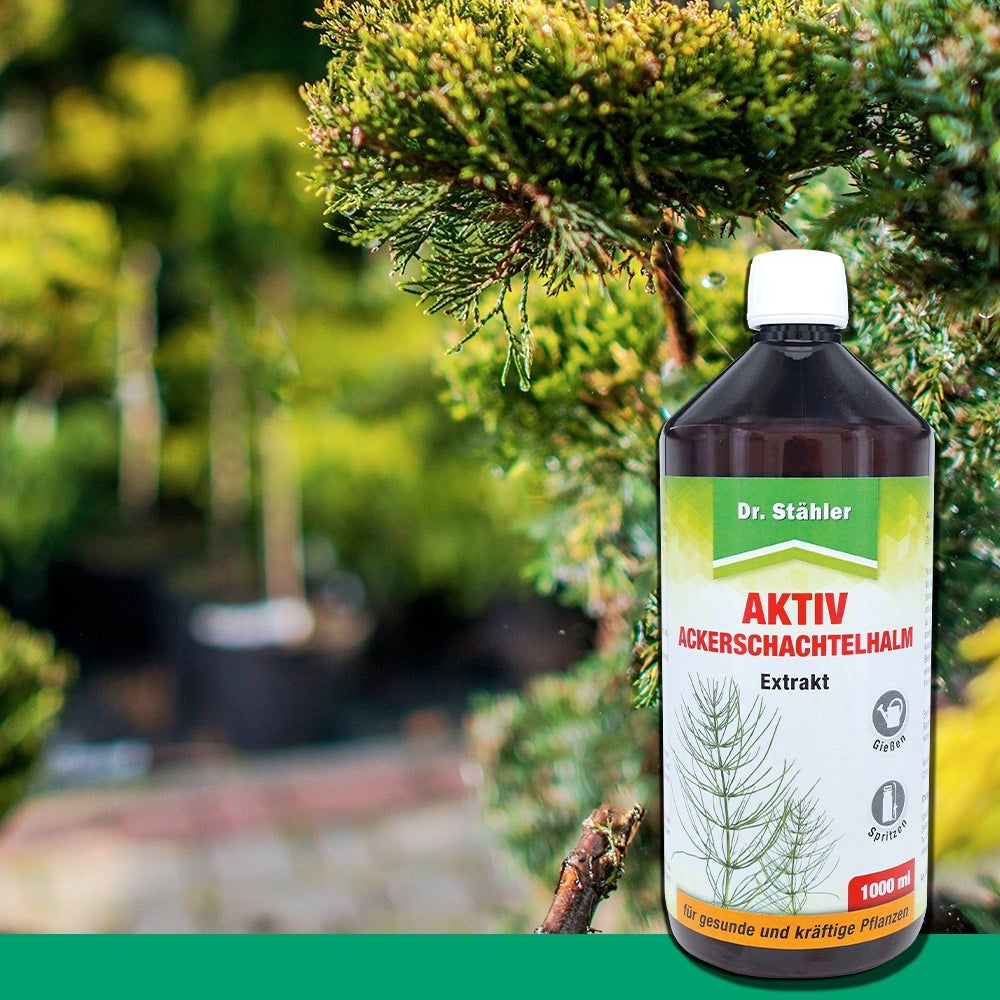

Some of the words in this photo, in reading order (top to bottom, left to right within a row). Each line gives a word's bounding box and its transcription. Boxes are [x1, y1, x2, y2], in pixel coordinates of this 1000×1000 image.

[737, 502, 765, 520] Dr.
[772, 502, 852, 521] Stähler
[742, 592, 848, 625] AKTIV
[678, 626, 914, 657] ACKERSCHACHTELHALM
[760, 673, 830, 691] Extrakt
[872, 734, 906, 753] Gießen
[868, 819, 907, 842] Spritzen
[860, 877, 895, 900] 1000
[897, 870, 911, 888] ml
[683, 903, 696, 921] für
[699, 913, 755, 937] gesunde
[760, 923, 789, 940] und
[794, 922, 856, 940] kräftige
[860, 906, 909, 933] Pflanzen
